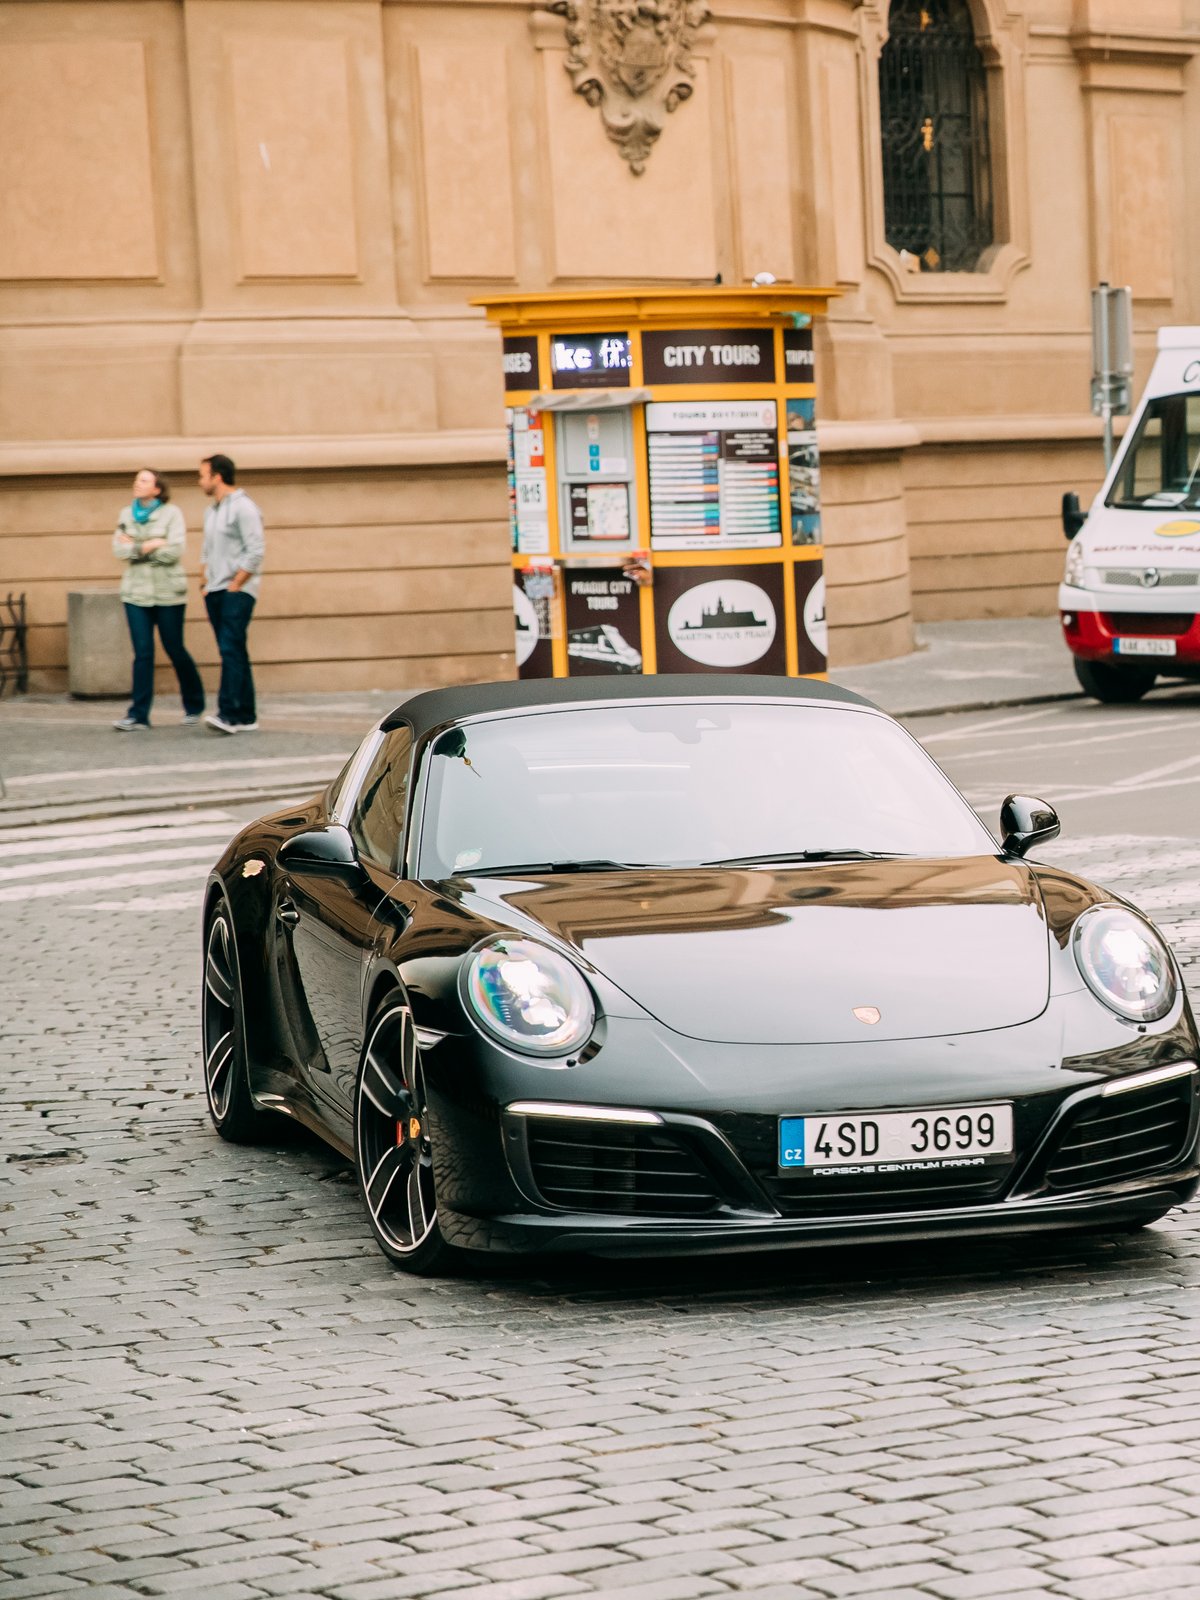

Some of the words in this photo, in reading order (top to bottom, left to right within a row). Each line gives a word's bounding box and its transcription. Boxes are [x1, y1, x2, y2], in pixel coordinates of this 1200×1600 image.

[663, 345, 706, 367] CITY
[710, 345, 760, 366] TOURS
[814, 1121, 879, 1158] 4SD
[911, 1113, 994, 1152] 3699
[784, 1149, 802, 1160] CZ
[813, 1165, 875, 1175] PORSCHE
[878, 1161, 940, 1172] CENTRUM
[942, 1157, 985, 1168] PRAHA
